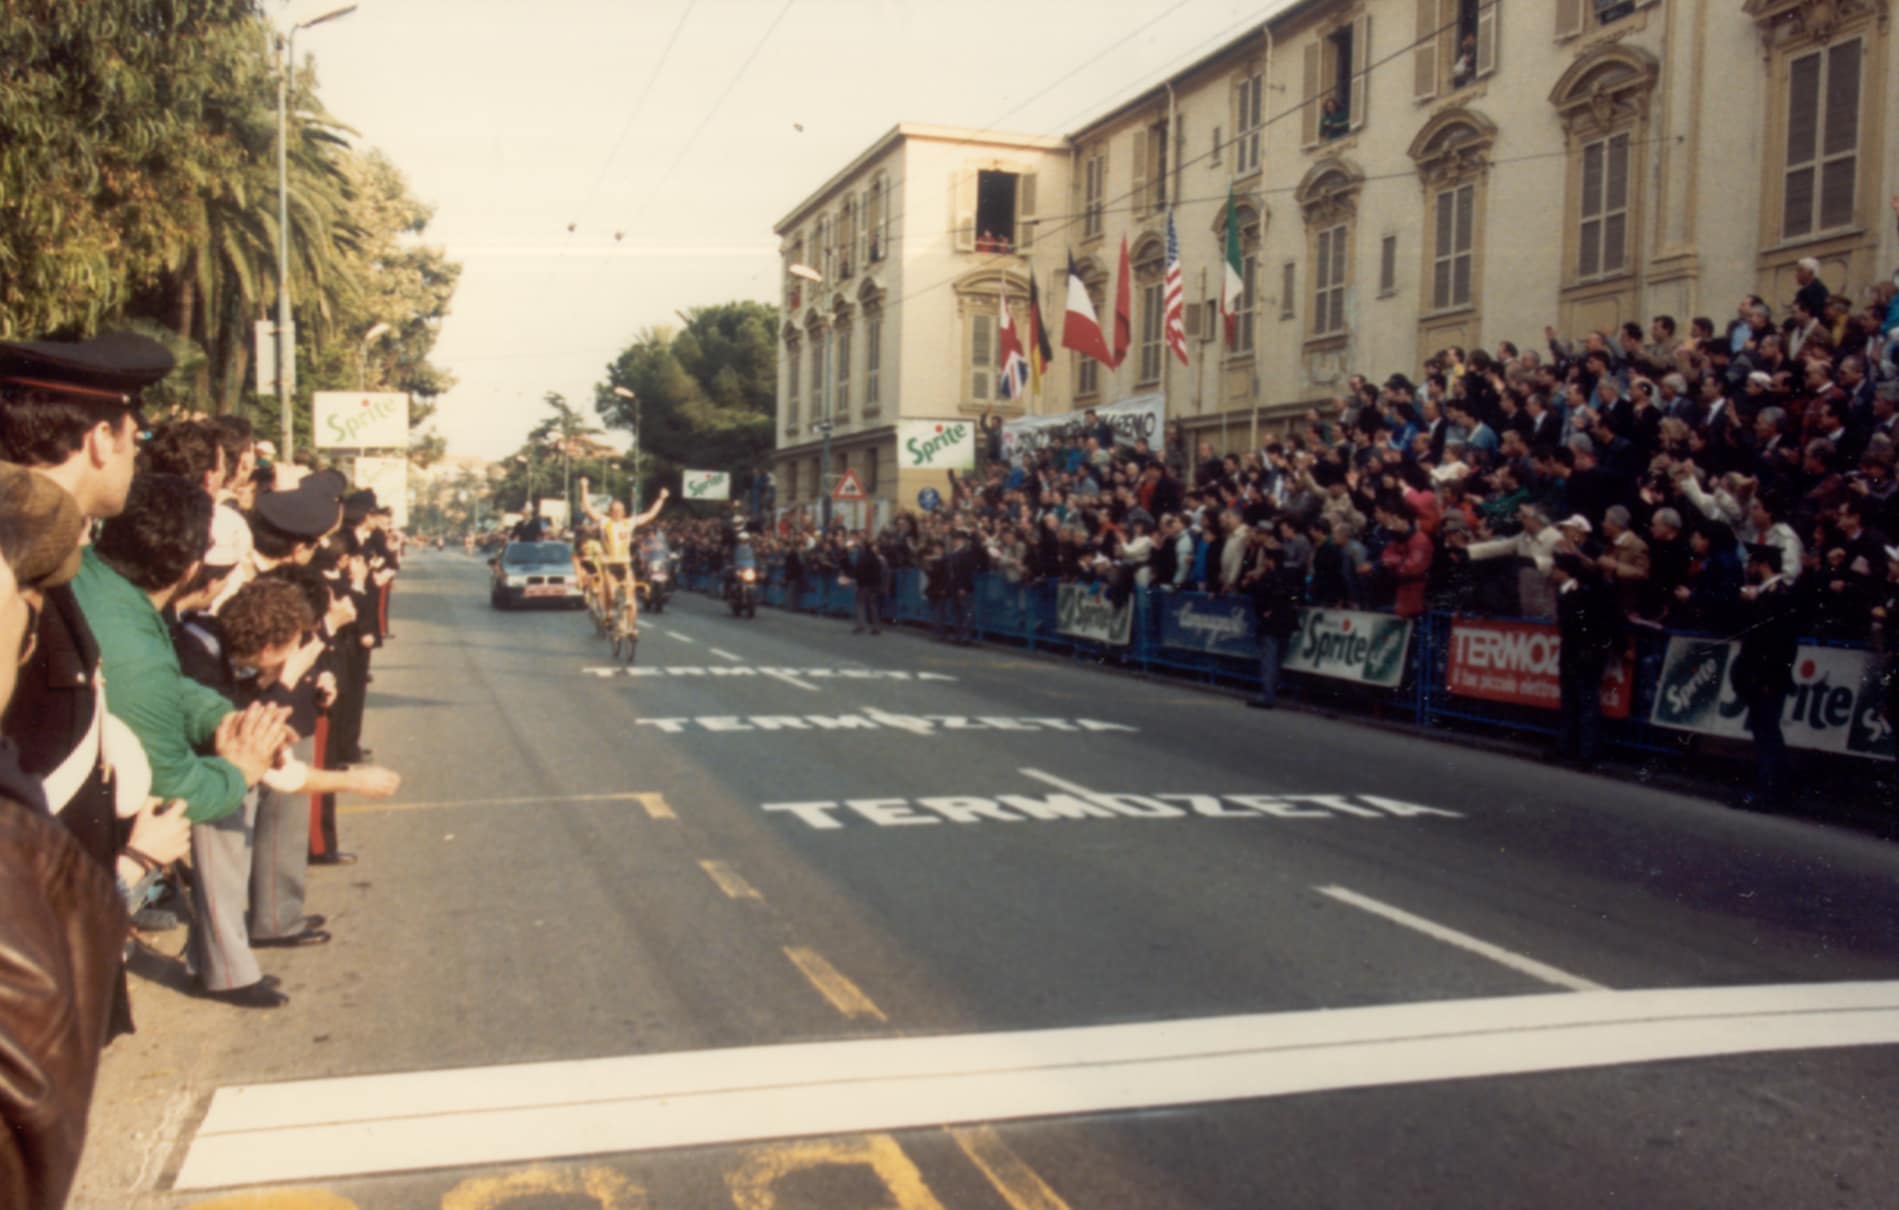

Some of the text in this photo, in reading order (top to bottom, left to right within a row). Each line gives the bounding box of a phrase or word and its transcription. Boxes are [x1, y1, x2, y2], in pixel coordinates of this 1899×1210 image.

[906, 423, 967, 465] Sprite
[1303, 611, 1367, 667] Sprite
[762, 793, 1464, 830] TERMOZETA
